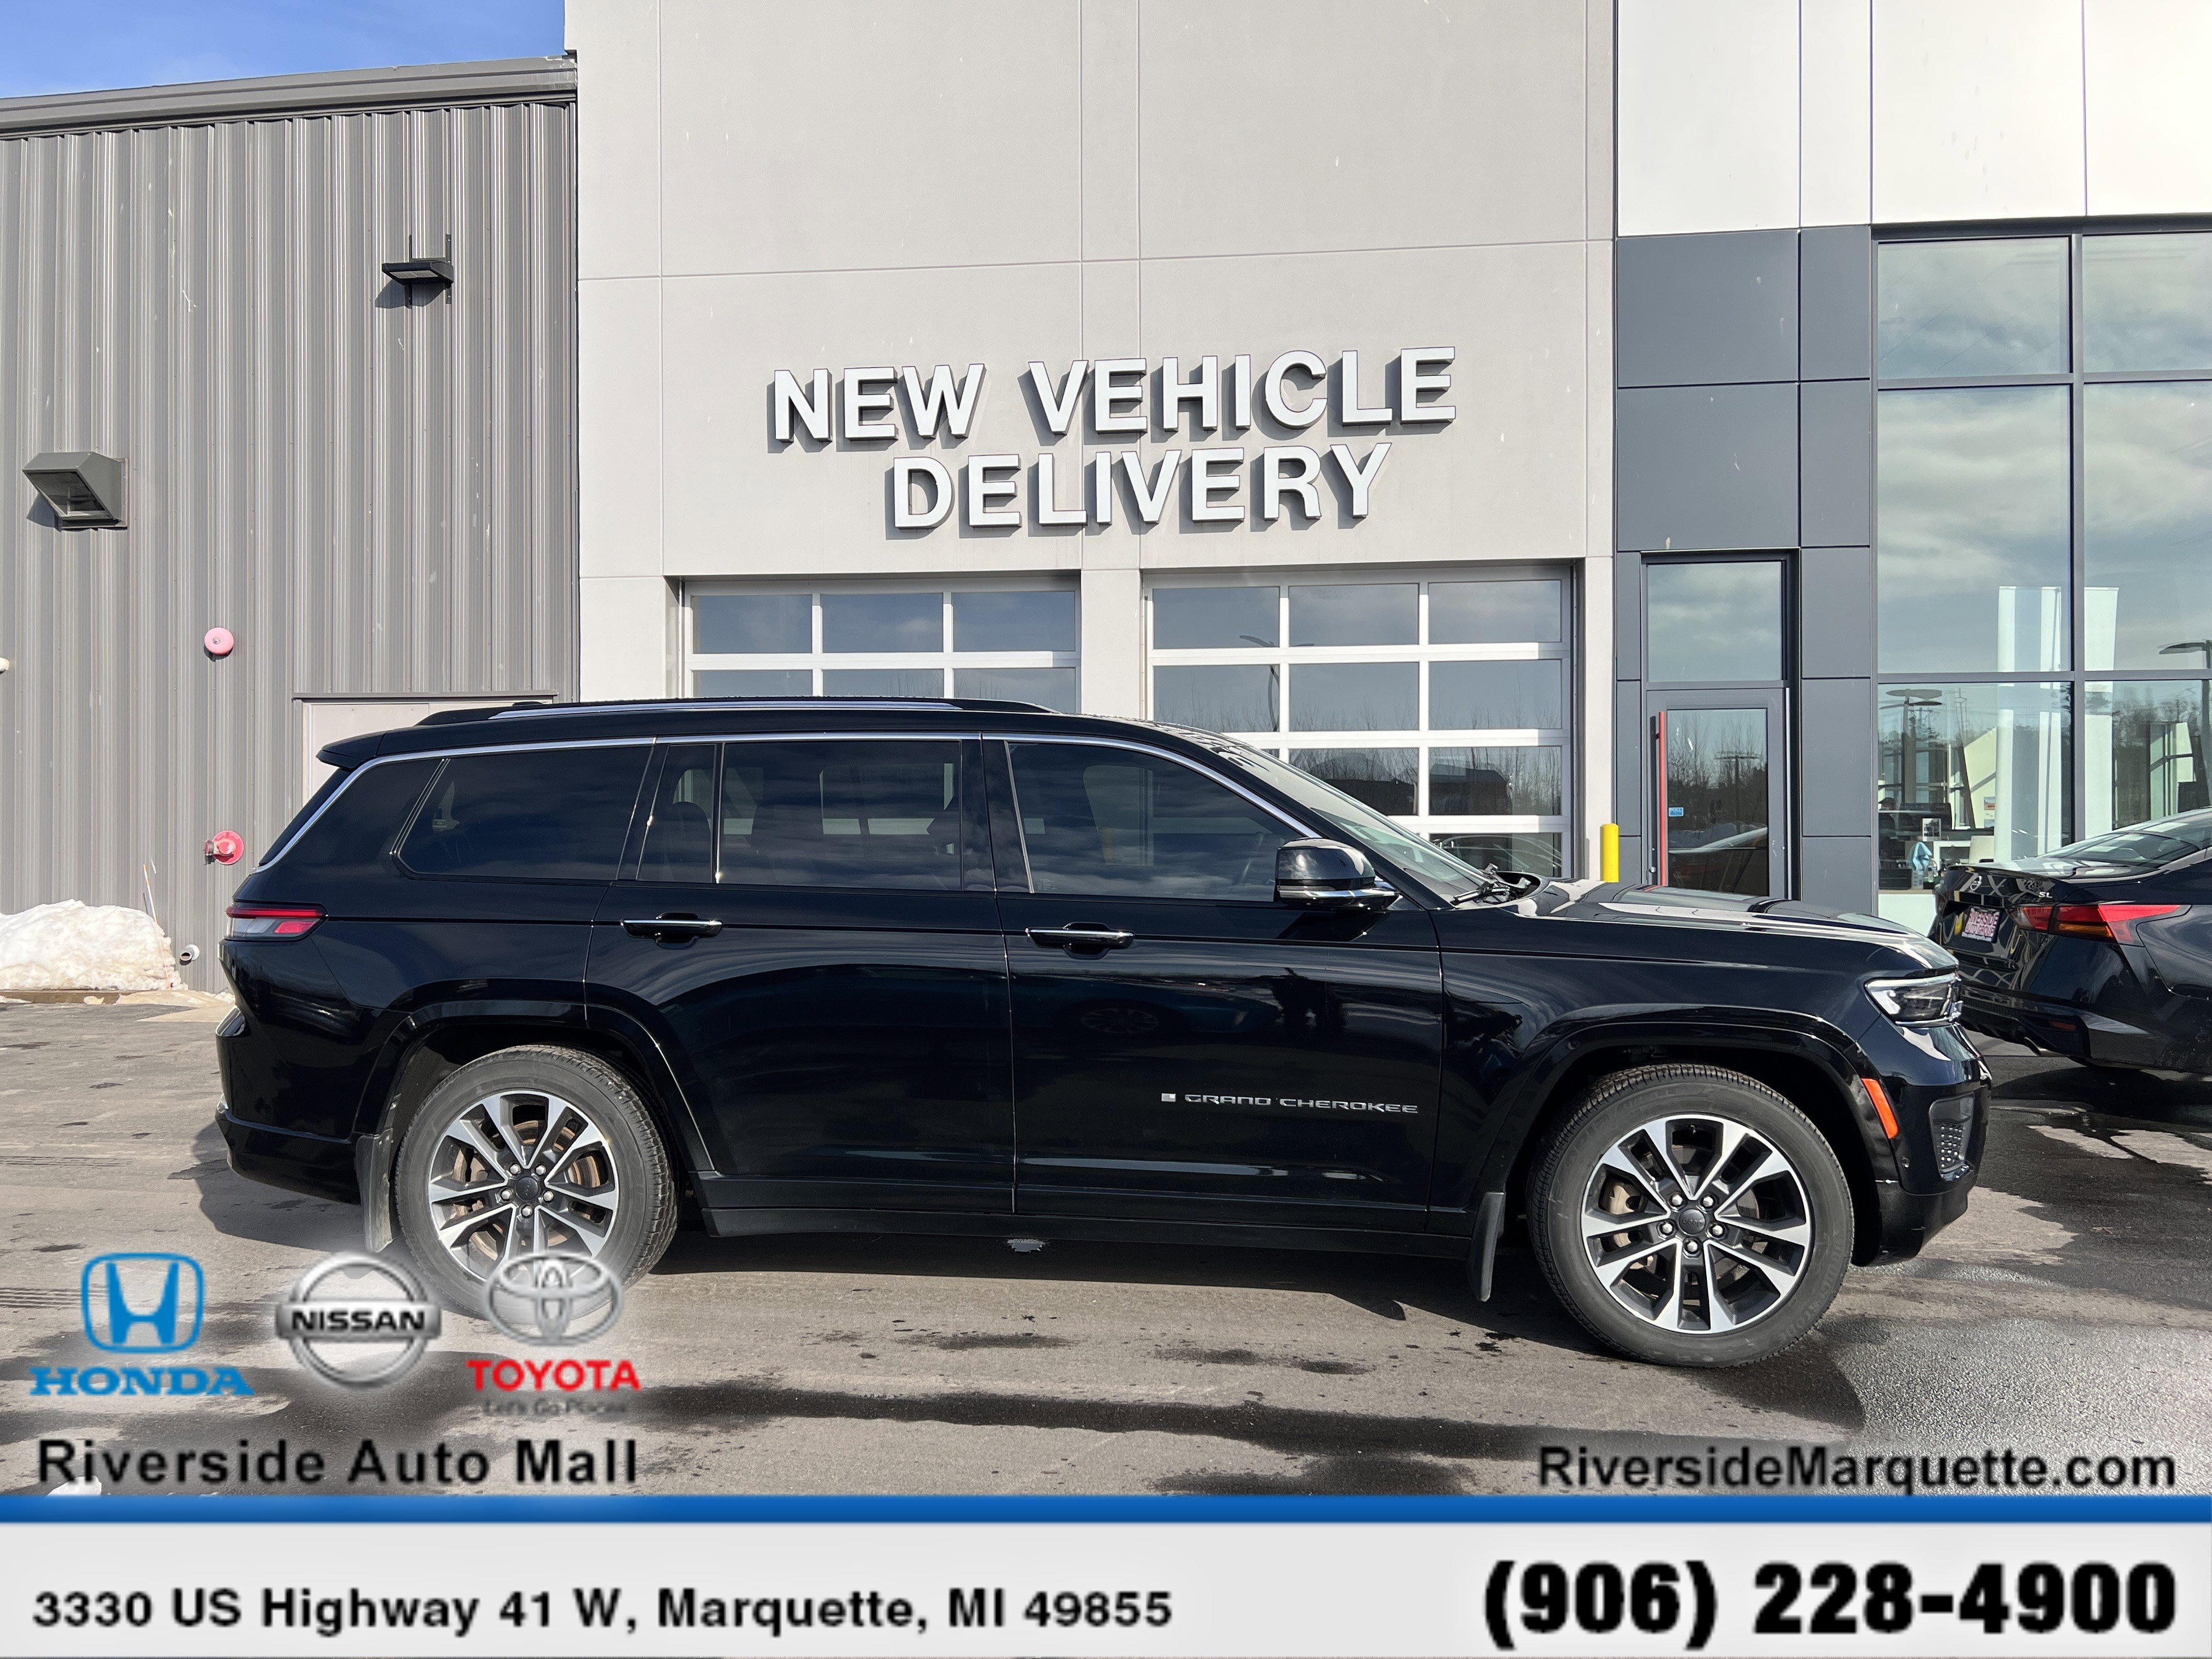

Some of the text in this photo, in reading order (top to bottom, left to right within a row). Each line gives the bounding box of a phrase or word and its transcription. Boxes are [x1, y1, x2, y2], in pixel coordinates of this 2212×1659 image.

[774, 347, 1455, 443] NEW VEHICLE
[894, 443, 1392, 529] DELIVERY
[1969, 910, 1999, 926] RIVERSIDE
[1977, 924, 1995, 936] GROUP
[1184, 1093, 1418, 1114] GRAND CHEROKEE
